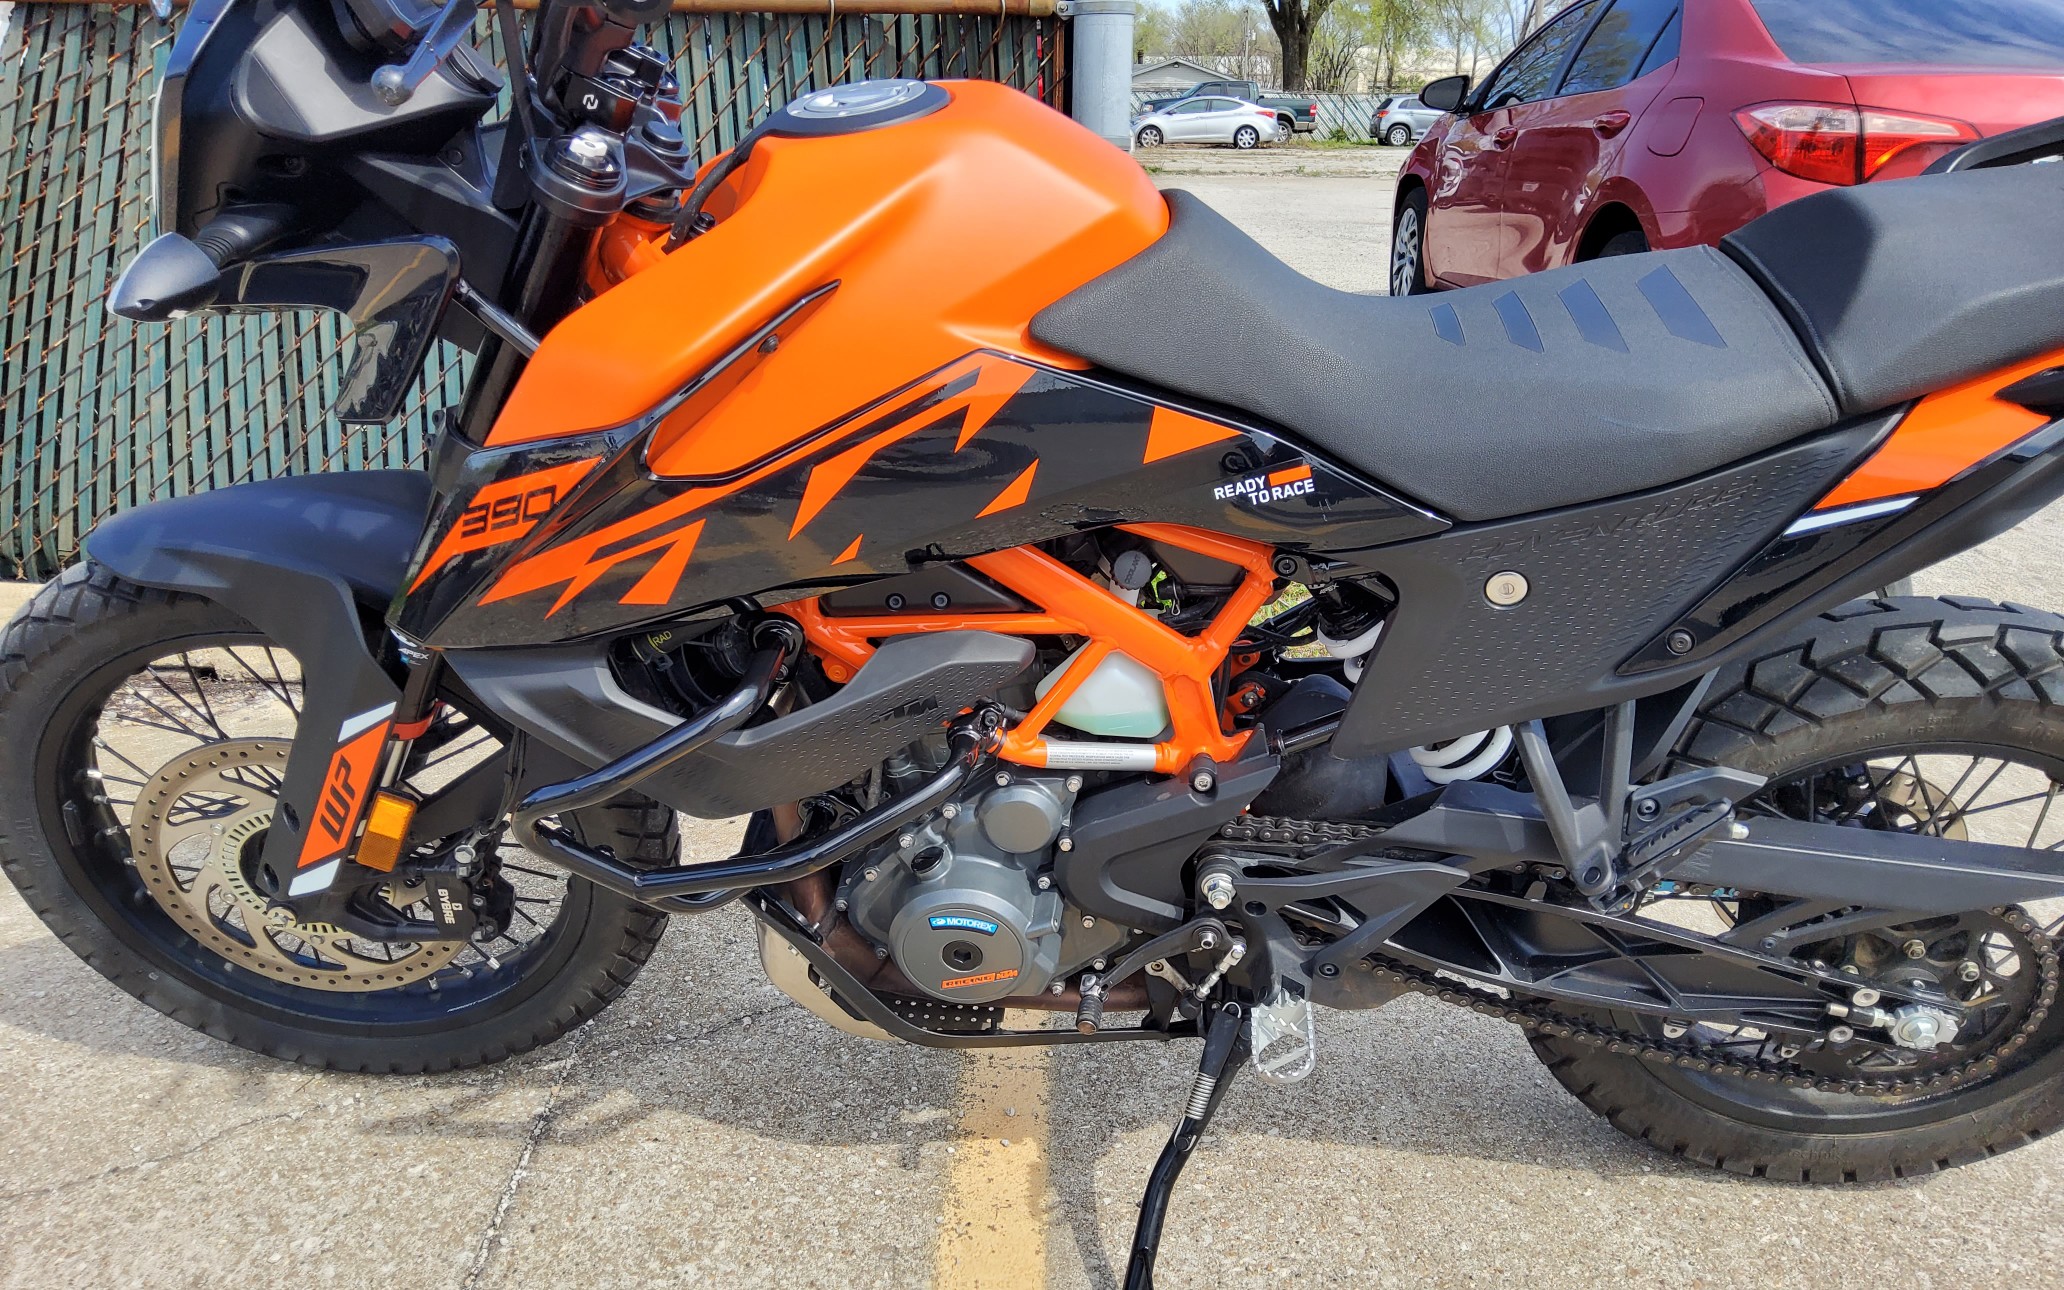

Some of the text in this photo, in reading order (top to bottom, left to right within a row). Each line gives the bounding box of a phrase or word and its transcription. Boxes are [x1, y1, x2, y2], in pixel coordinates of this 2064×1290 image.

[1214, 476, 1265, 500] READY
[1248, 478, 1315, 505] TO RACE
[461, 485, 557, 539] 390
[652, 630, 672, 646] RAD
[399, 648, 429, 660] APEX
[319, 754, 355, 844] WP
[437, 889, 455, 924] BYBRE
[947, 918, 993, 931] MOTOREX
[945, 975, 992, 987] RACING
